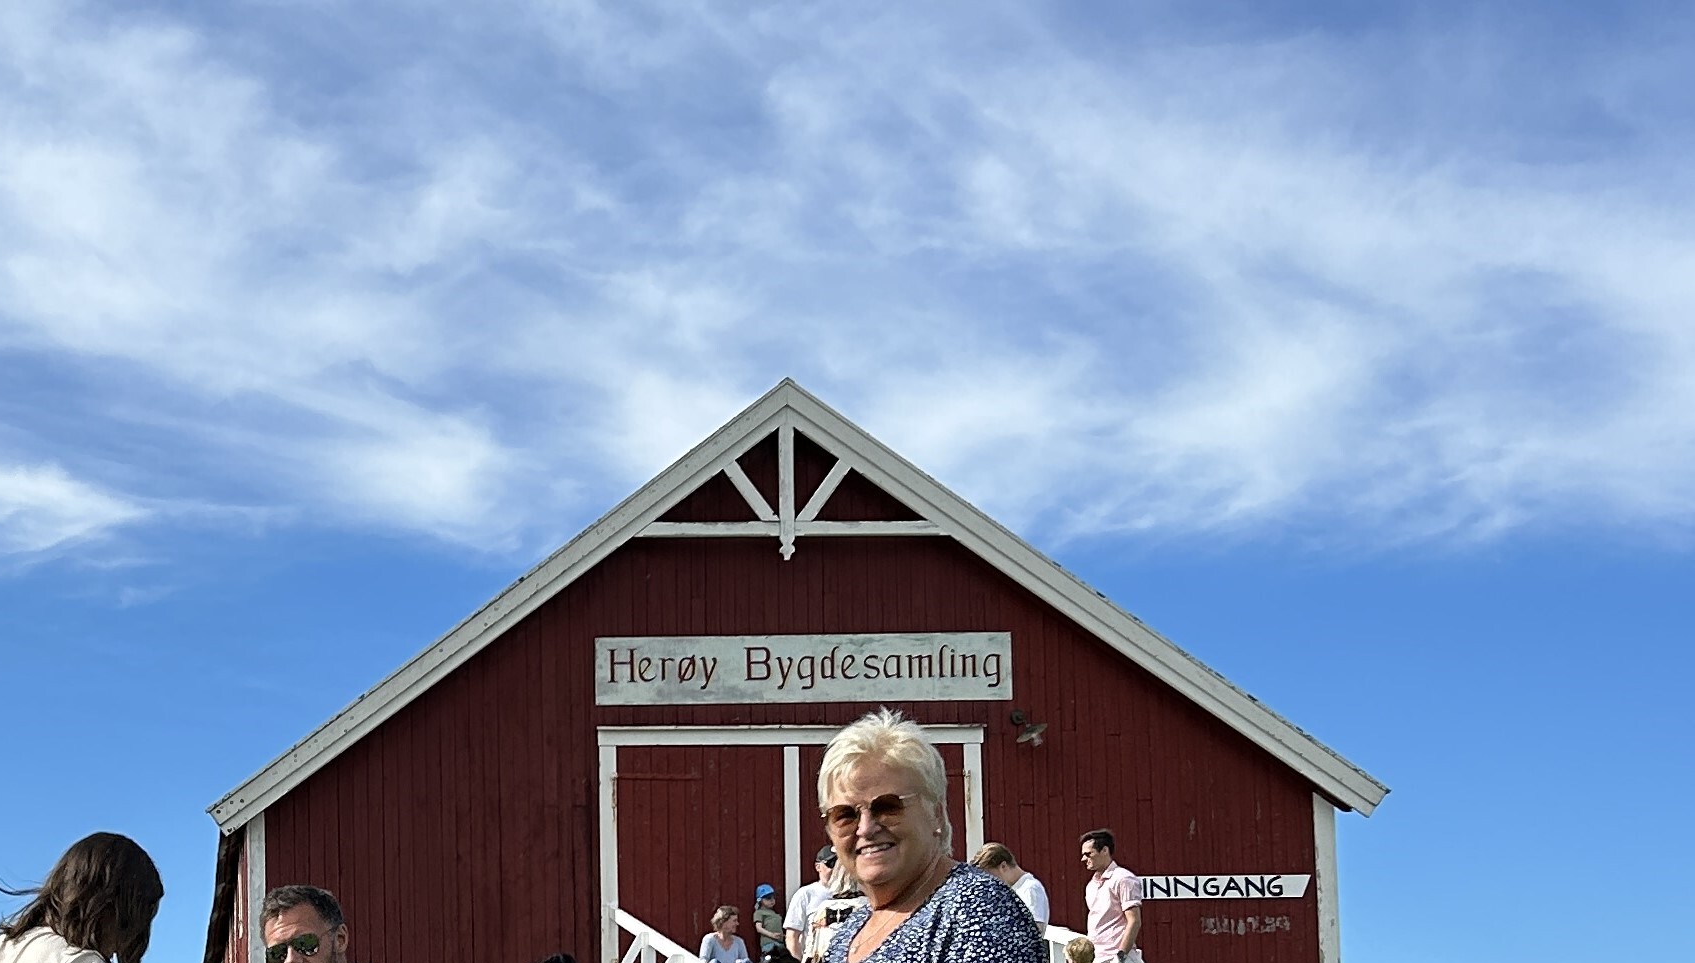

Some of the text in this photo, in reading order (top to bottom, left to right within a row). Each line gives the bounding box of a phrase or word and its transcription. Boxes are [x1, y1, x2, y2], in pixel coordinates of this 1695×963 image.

[607, 643, 1002, 690] Herøy Bygdesamling
[1142, 875, 1284, 899] INNGANG
